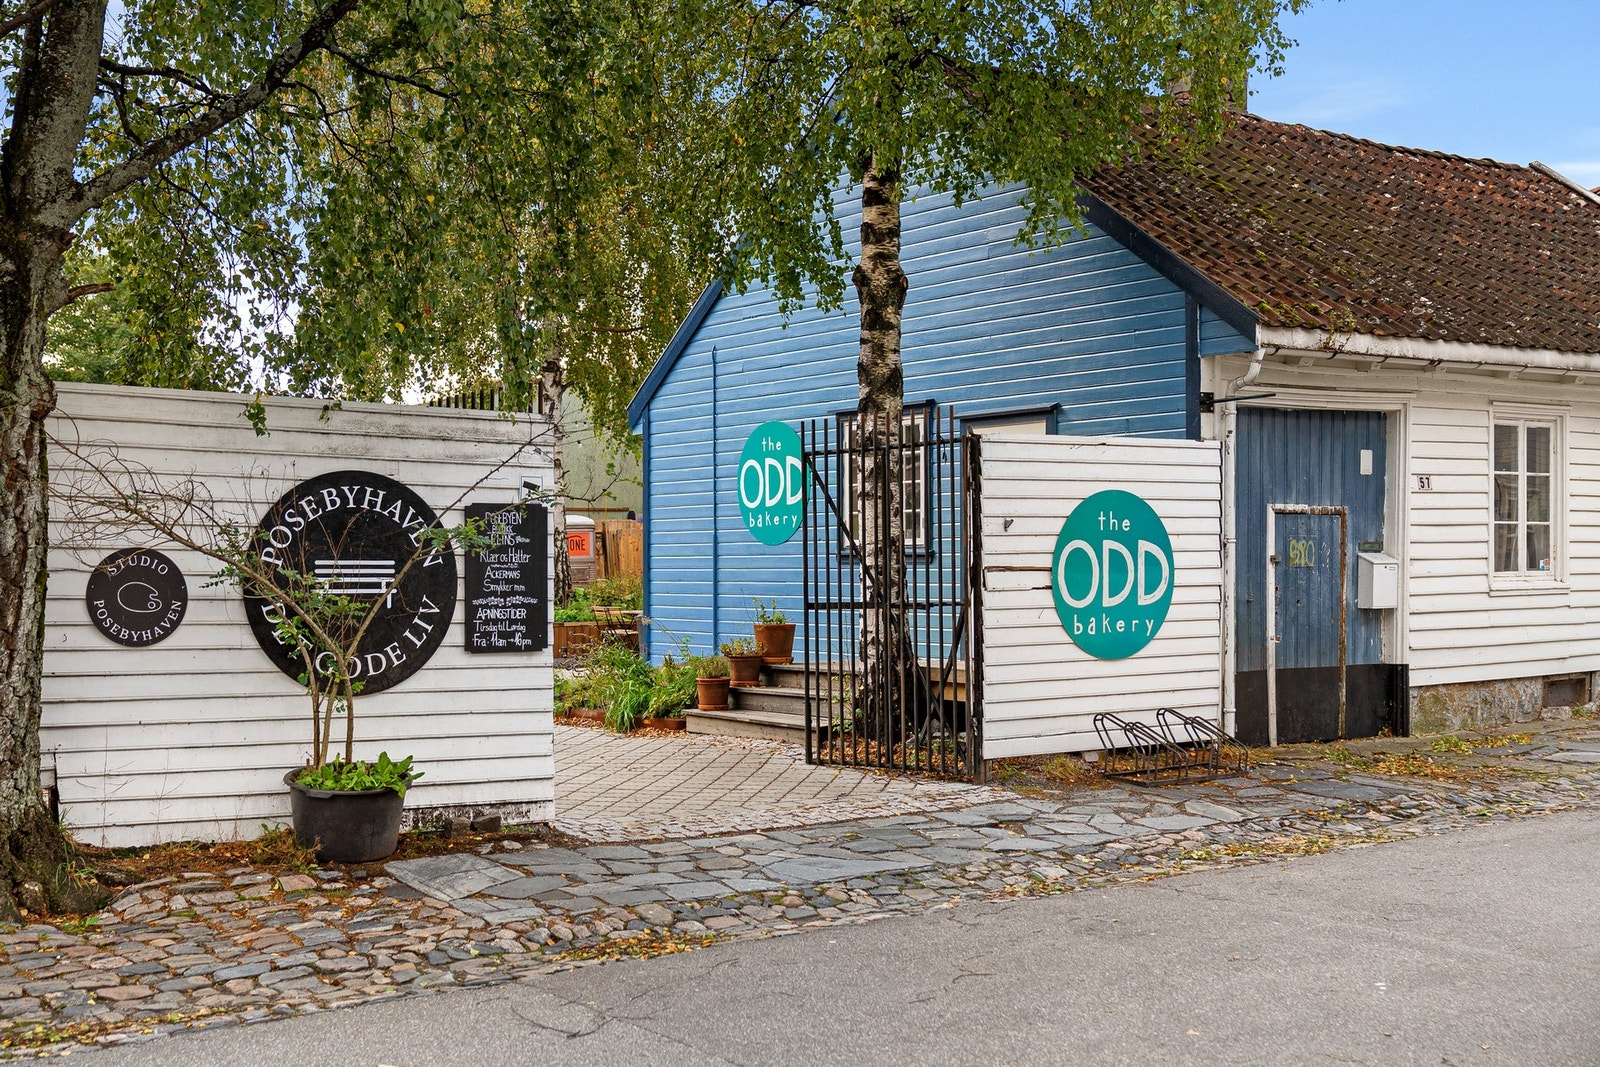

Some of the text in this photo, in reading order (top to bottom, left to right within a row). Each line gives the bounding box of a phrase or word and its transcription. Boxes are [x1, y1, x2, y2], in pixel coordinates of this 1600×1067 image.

[761, 436, 782, 452] the
[740, 455, 803, 509] ODD
[749, 511, 798, 528] bakery
[1098, 510, 1131, 532] the
[107, 555, 169, 576] STUDIO
[1057, 539, 1170, 609] ODD
[482, 579, 514, 595] Smykker
[94, 600, 182, 642] POSEBYHAVEN
[403, 594, 441, 649] LIV
[473, 620, 498, 632] Tirsdag
[1073, 613, 1155, 637] bakery
